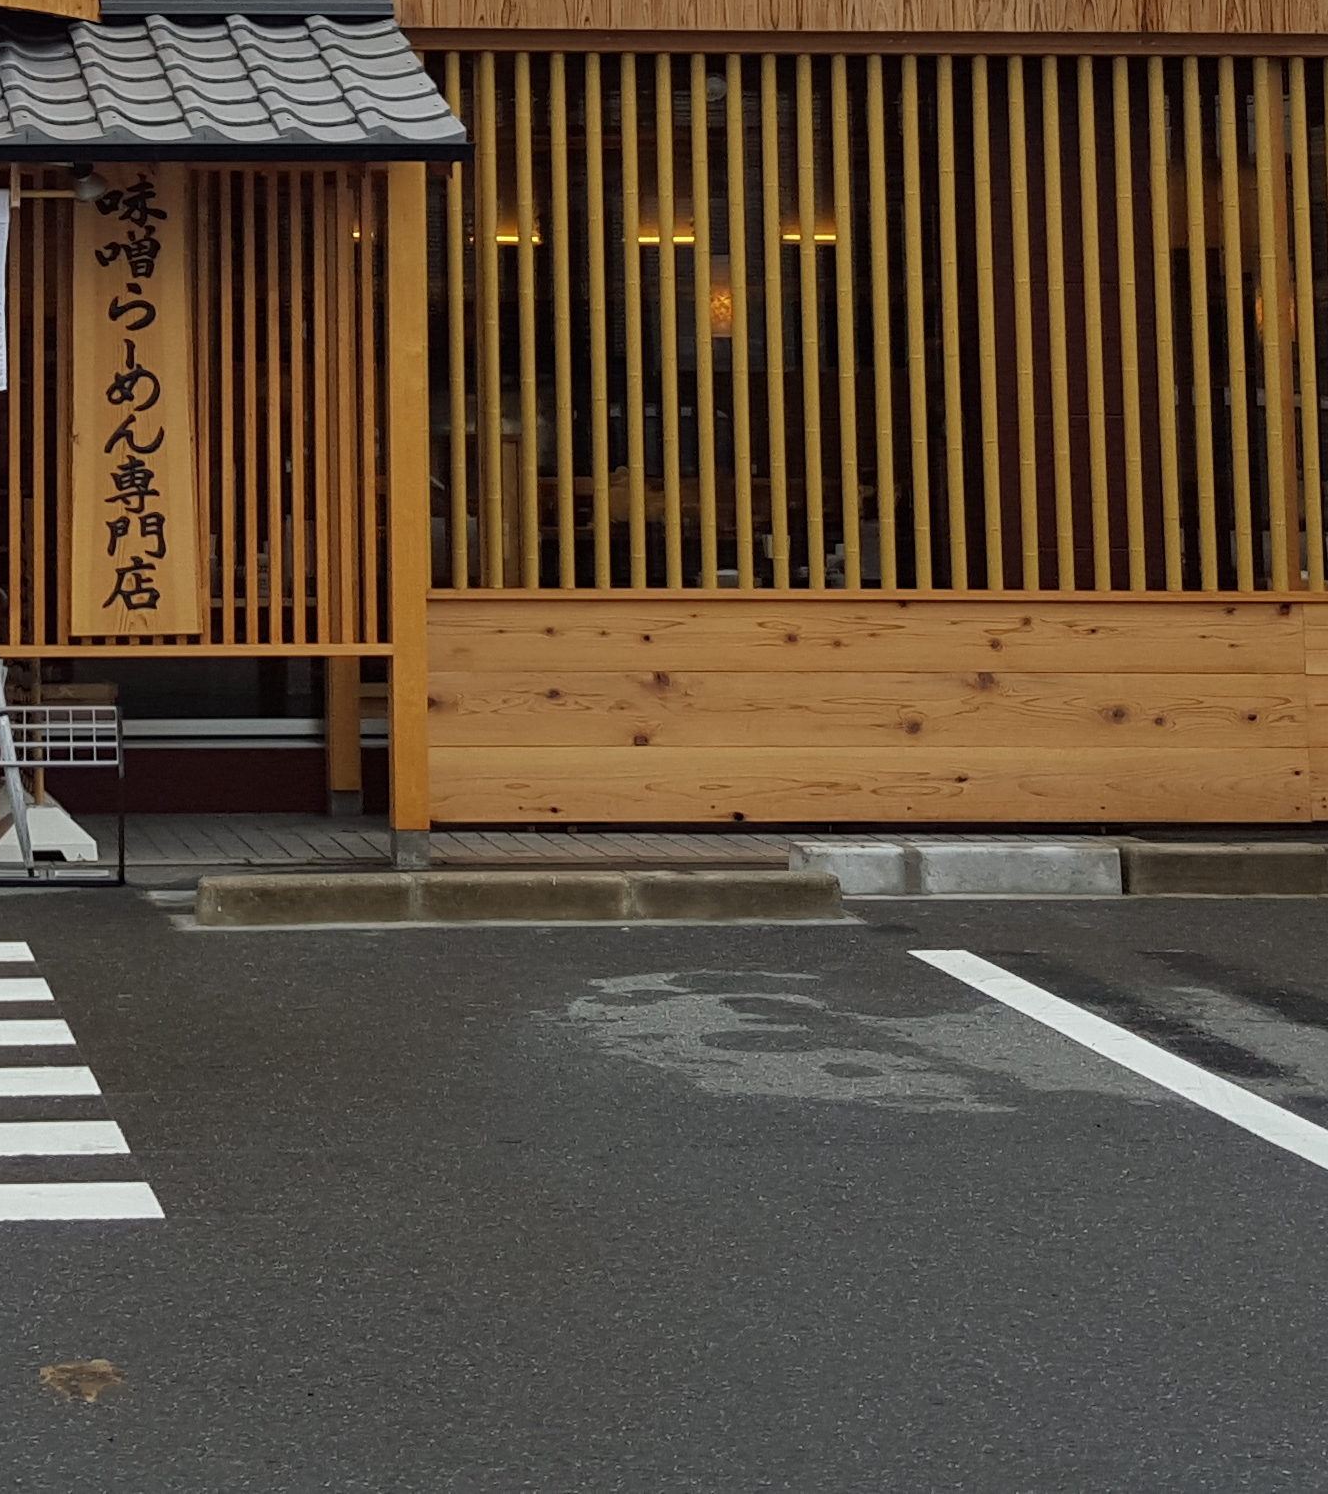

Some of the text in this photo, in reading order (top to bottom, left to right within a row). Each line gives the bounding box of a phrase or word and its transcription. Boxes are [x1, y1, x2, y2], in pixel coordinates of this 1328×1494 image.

[94, 173, 169, 610] 味噌らーめん専門店
